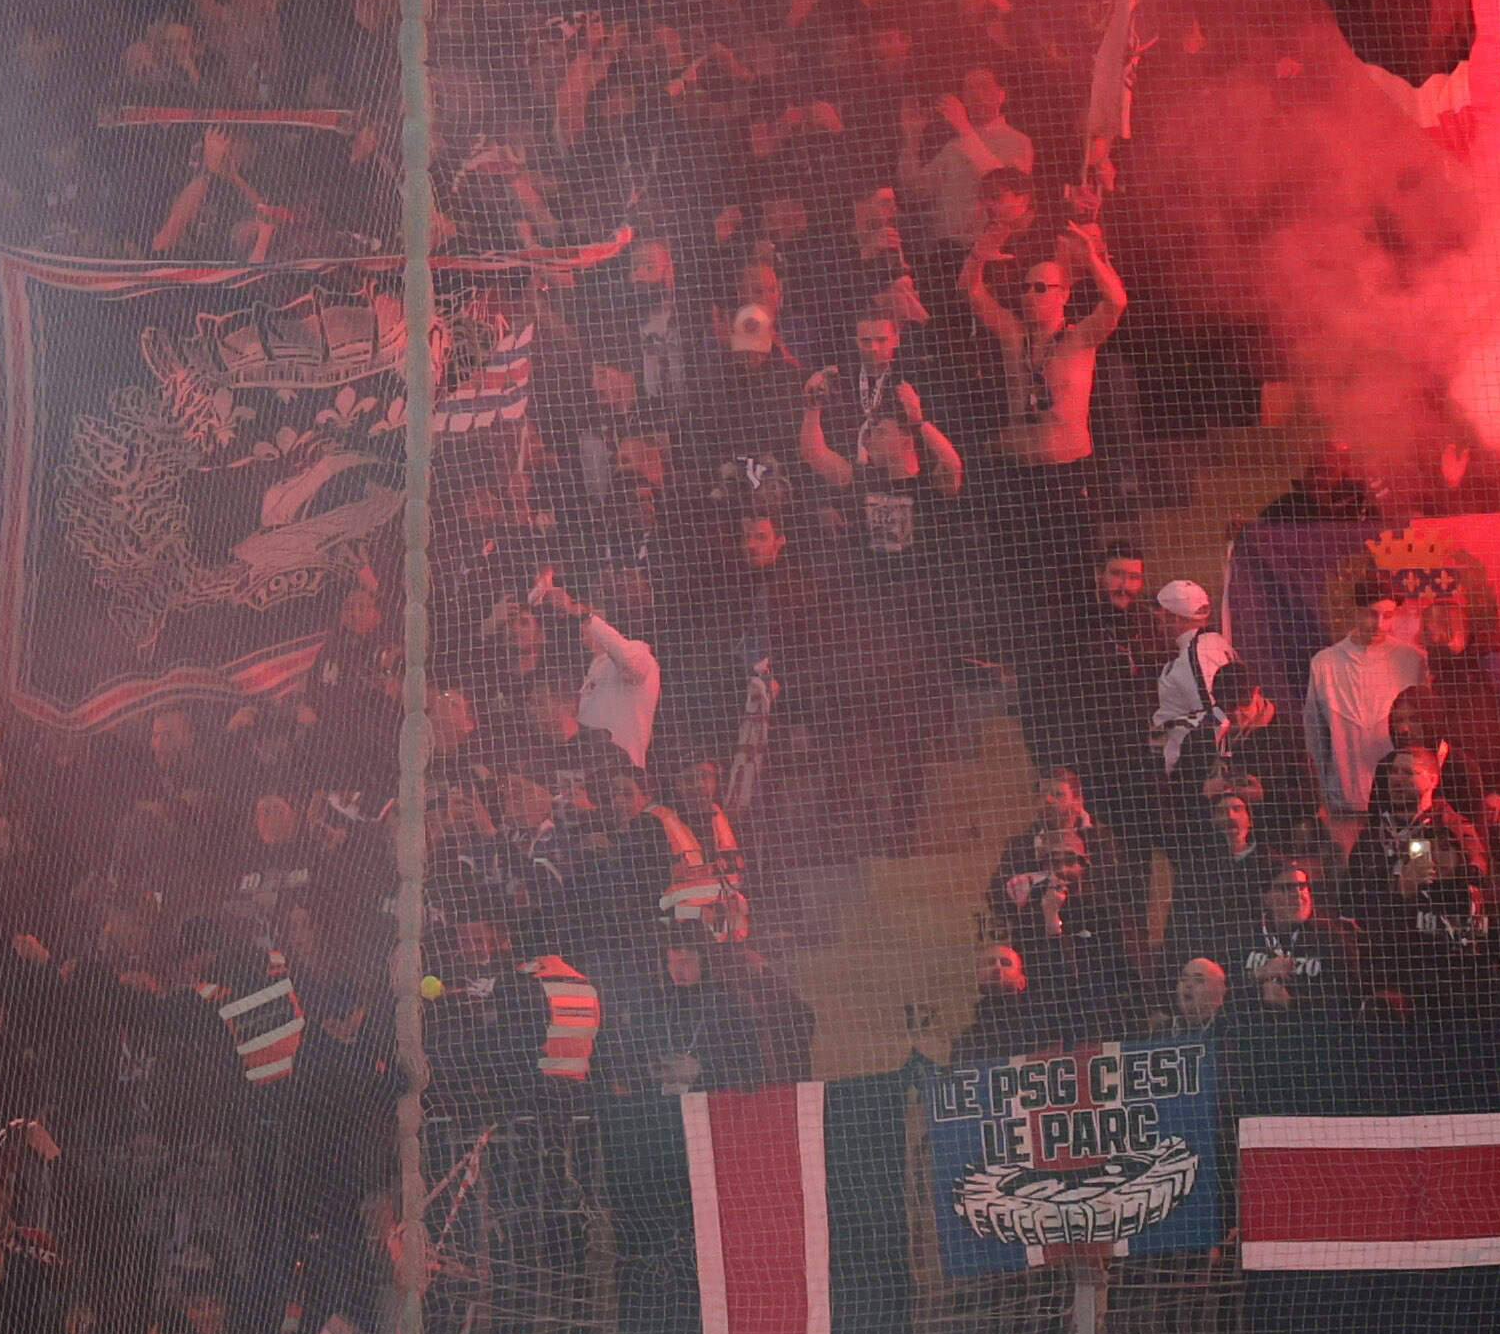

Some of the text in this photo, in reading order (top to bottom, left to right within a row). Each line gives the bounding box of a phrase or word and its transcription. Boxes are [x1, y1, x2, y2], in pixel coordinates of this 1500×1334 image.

[932, 1069, 983, 1122] LE
[989, 1056, 1078, 1116] PSG
[980, 1102, 1160, 1168] LE PARC
